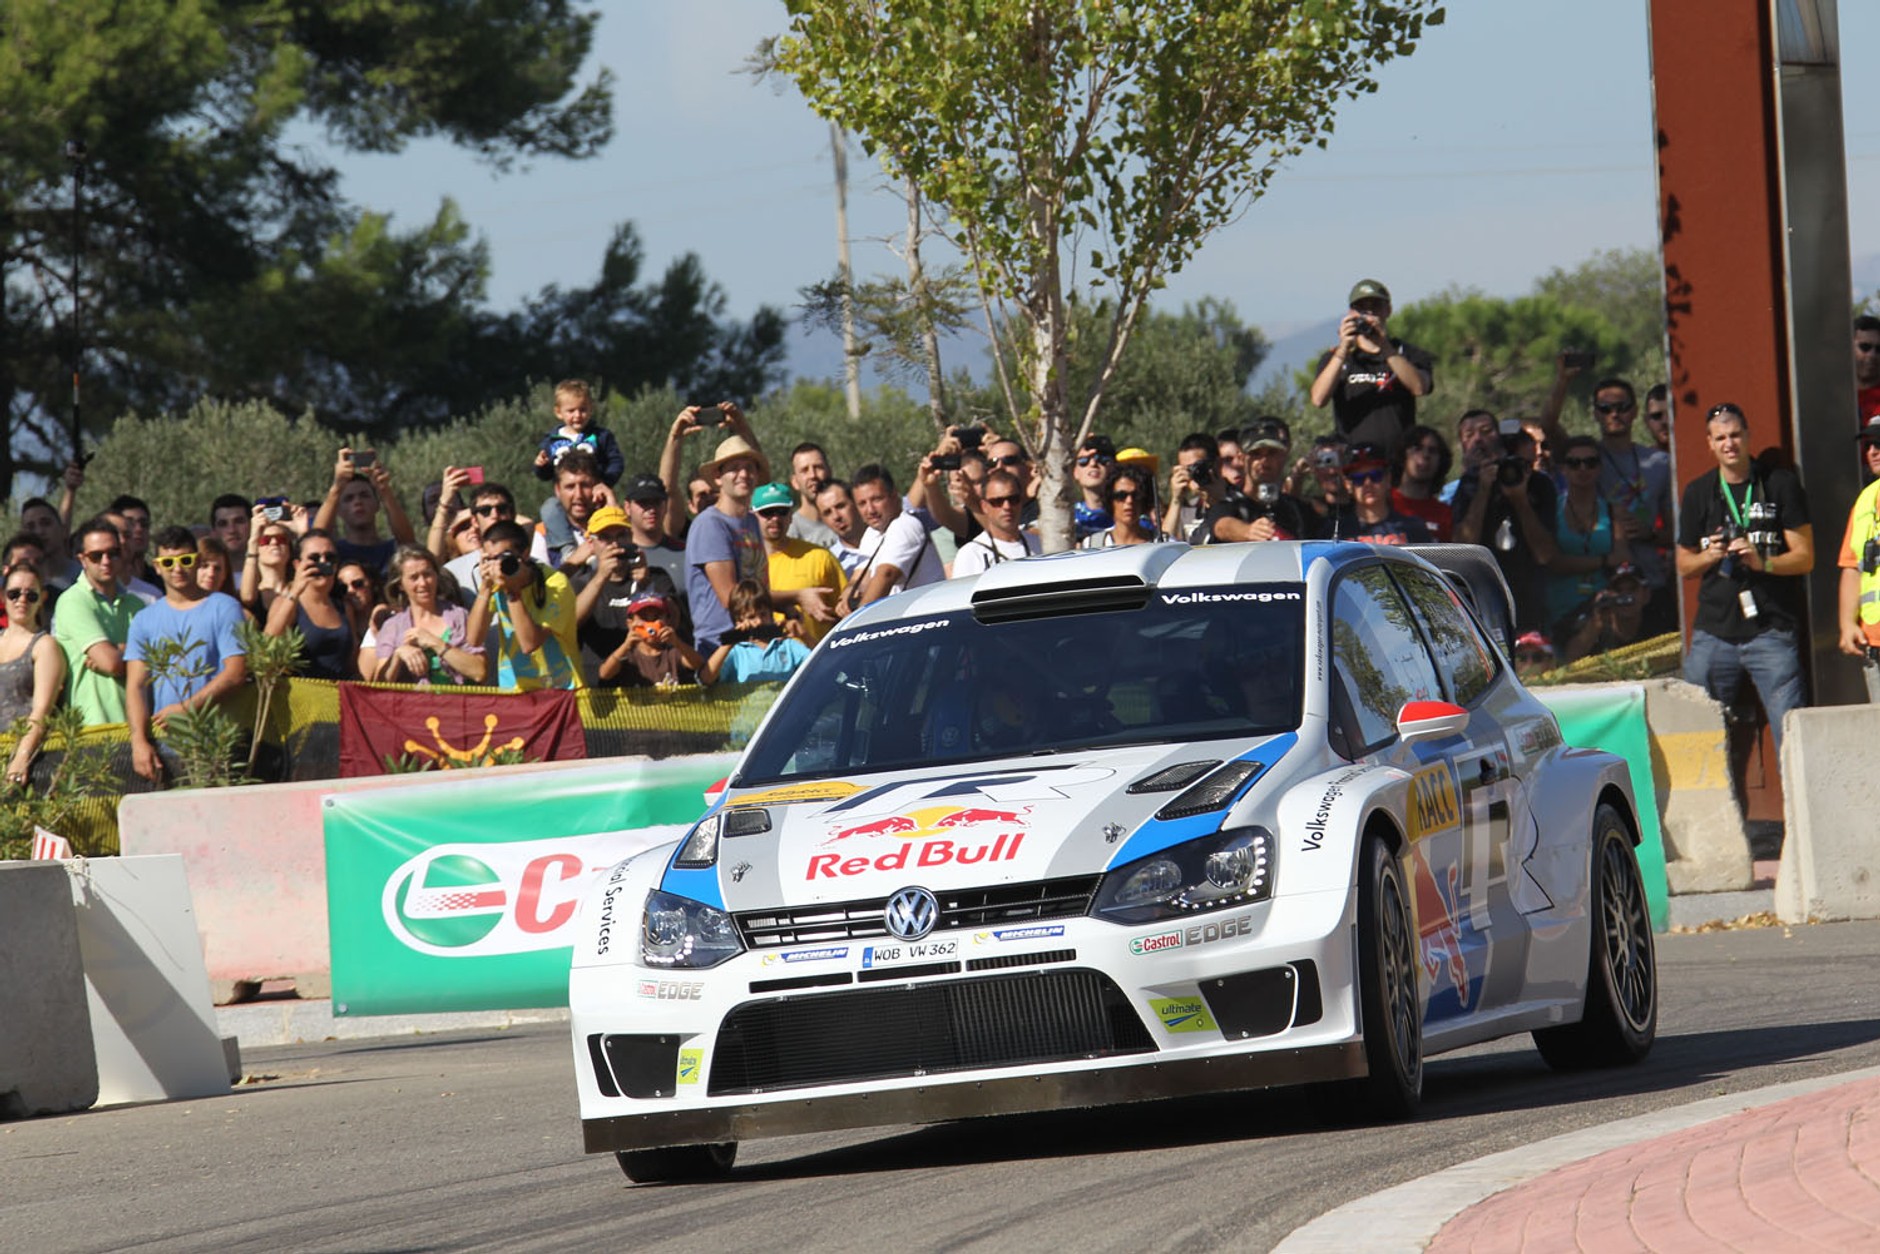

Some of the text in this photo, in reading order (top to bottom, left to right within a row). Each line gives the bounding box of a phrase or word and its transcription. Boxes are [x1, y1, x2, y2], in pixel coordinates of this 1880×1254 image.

[1161, 591, 1300, 604] Volkswagen
[829, 619, 950, 649] Volkswagen
[1415, 770, 1455, 832] RACC
[1302, 780, 1344, 852] Volkswagen
[805, 833, 1026, 881] Red Bull
[598, 887, 622, 955] Services
[995, 925, 1065, 940] MICHELIN
[1144, 916, 1252, 951] Castrol EDGE
[786, 947, 848, 962] MICHELIN
[874, 943, 956, 961] WOB VW 362
[657, 981, 705, 1000] EDGE
[1161, 1002, 1201, 1015] ultimate
